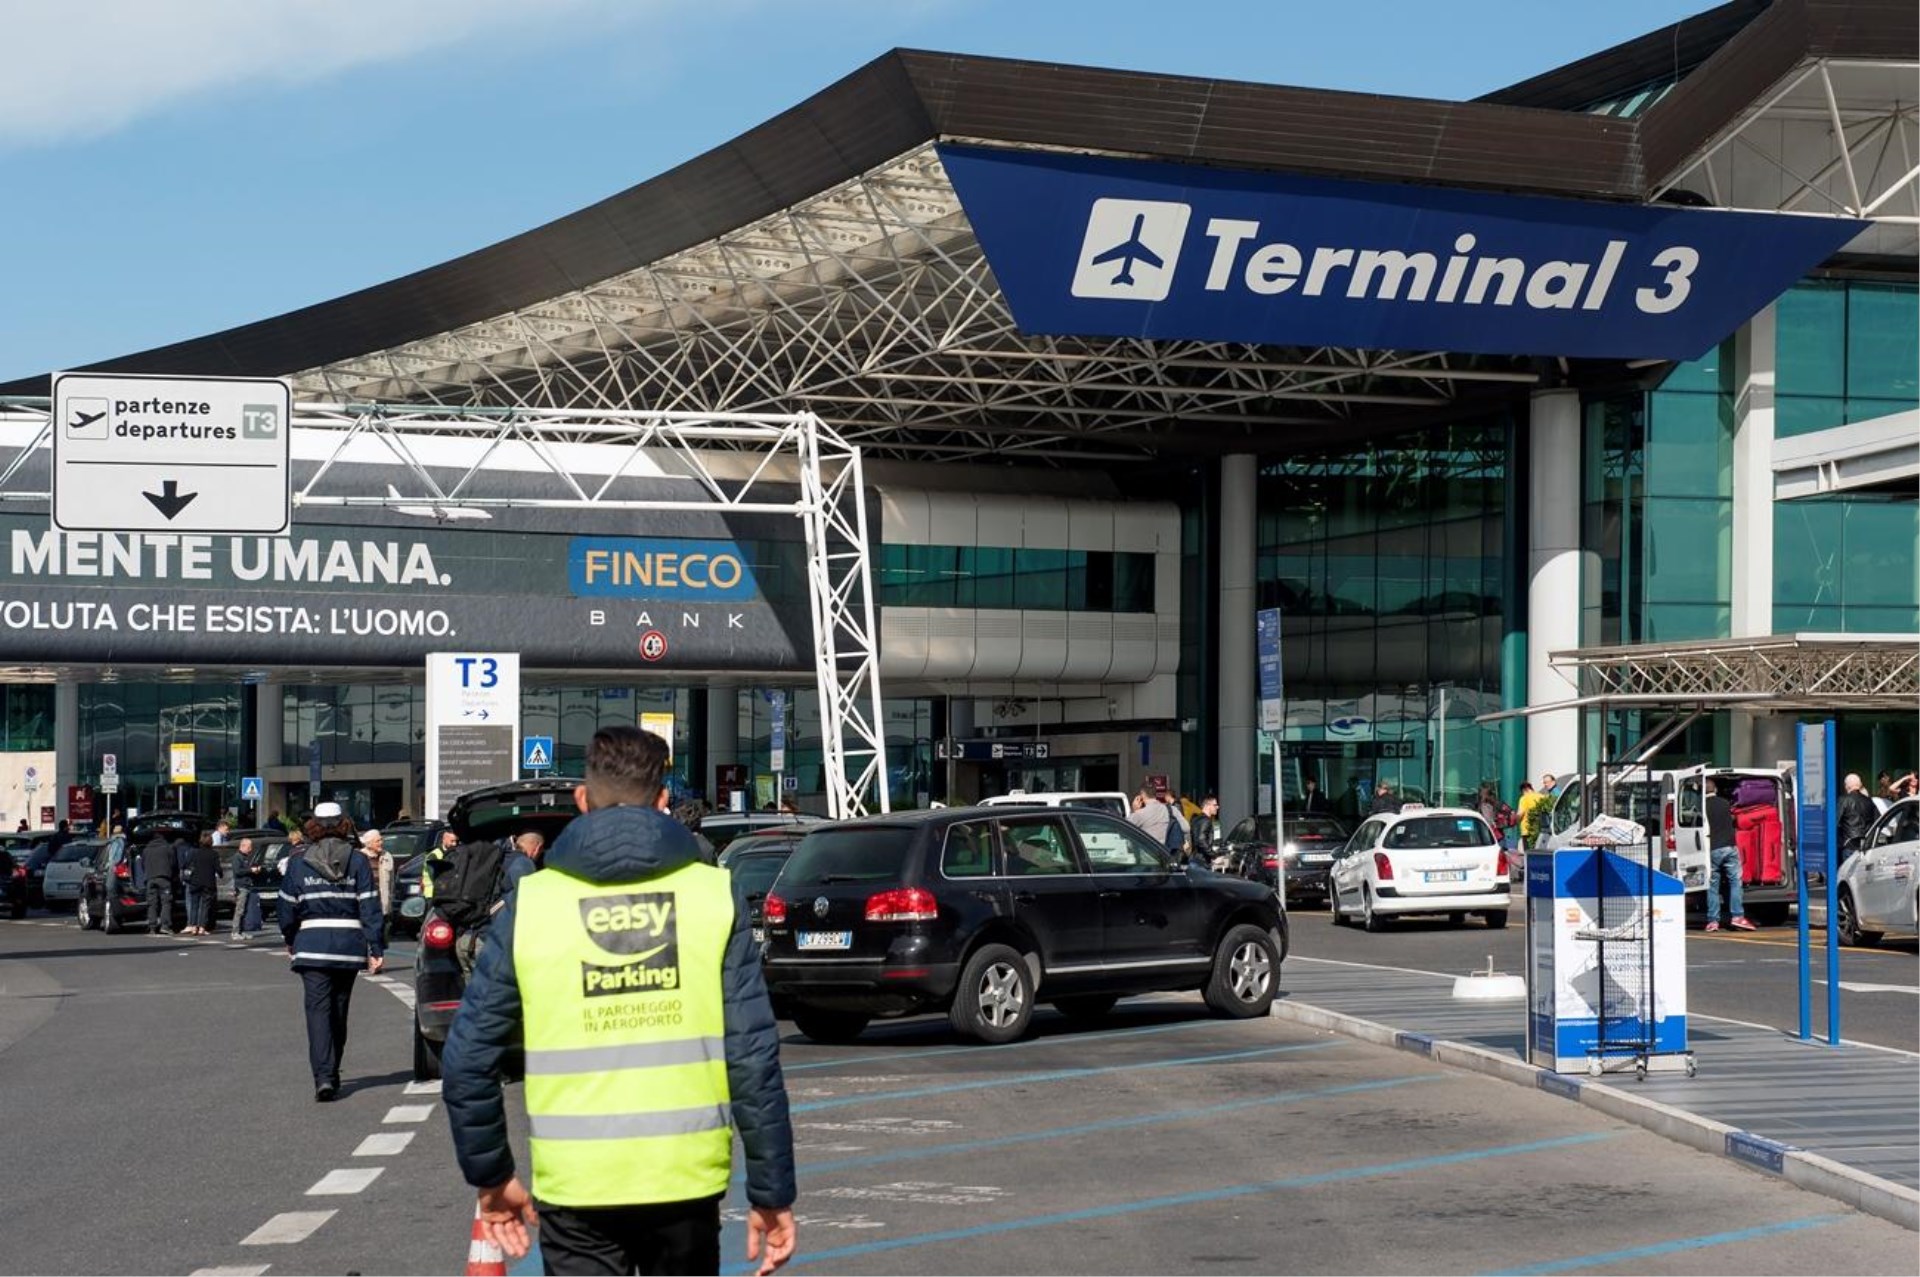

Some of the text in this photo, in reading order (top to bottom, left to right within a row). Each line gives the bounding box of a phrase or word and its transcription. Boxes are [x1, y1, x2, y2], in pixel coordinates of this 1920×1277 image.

[1205, 218, 1700, 314] Terminal 3
[115, 398, 211, 415] partenze
[244, 411, 276, 432] T3
[115, 421, 236, 440] departures
[11, 530, 452, 587] MENTE UMANA.
[585, 550, 742, 589] FINECO
[0, 602, 456, 637] OLUTA CHE ESISTA: L'UOMO.
[455, 658, 498, 688] T3
[1137, 735, 1150, 766] 1
[587, 901, 672, 937] easy
[586, 965, 677, 991] Parking
[584, 1000, 682, 1020] IL PARCHEGGIO
[584, 1013, 683, 1032] IN AEROPORTO
